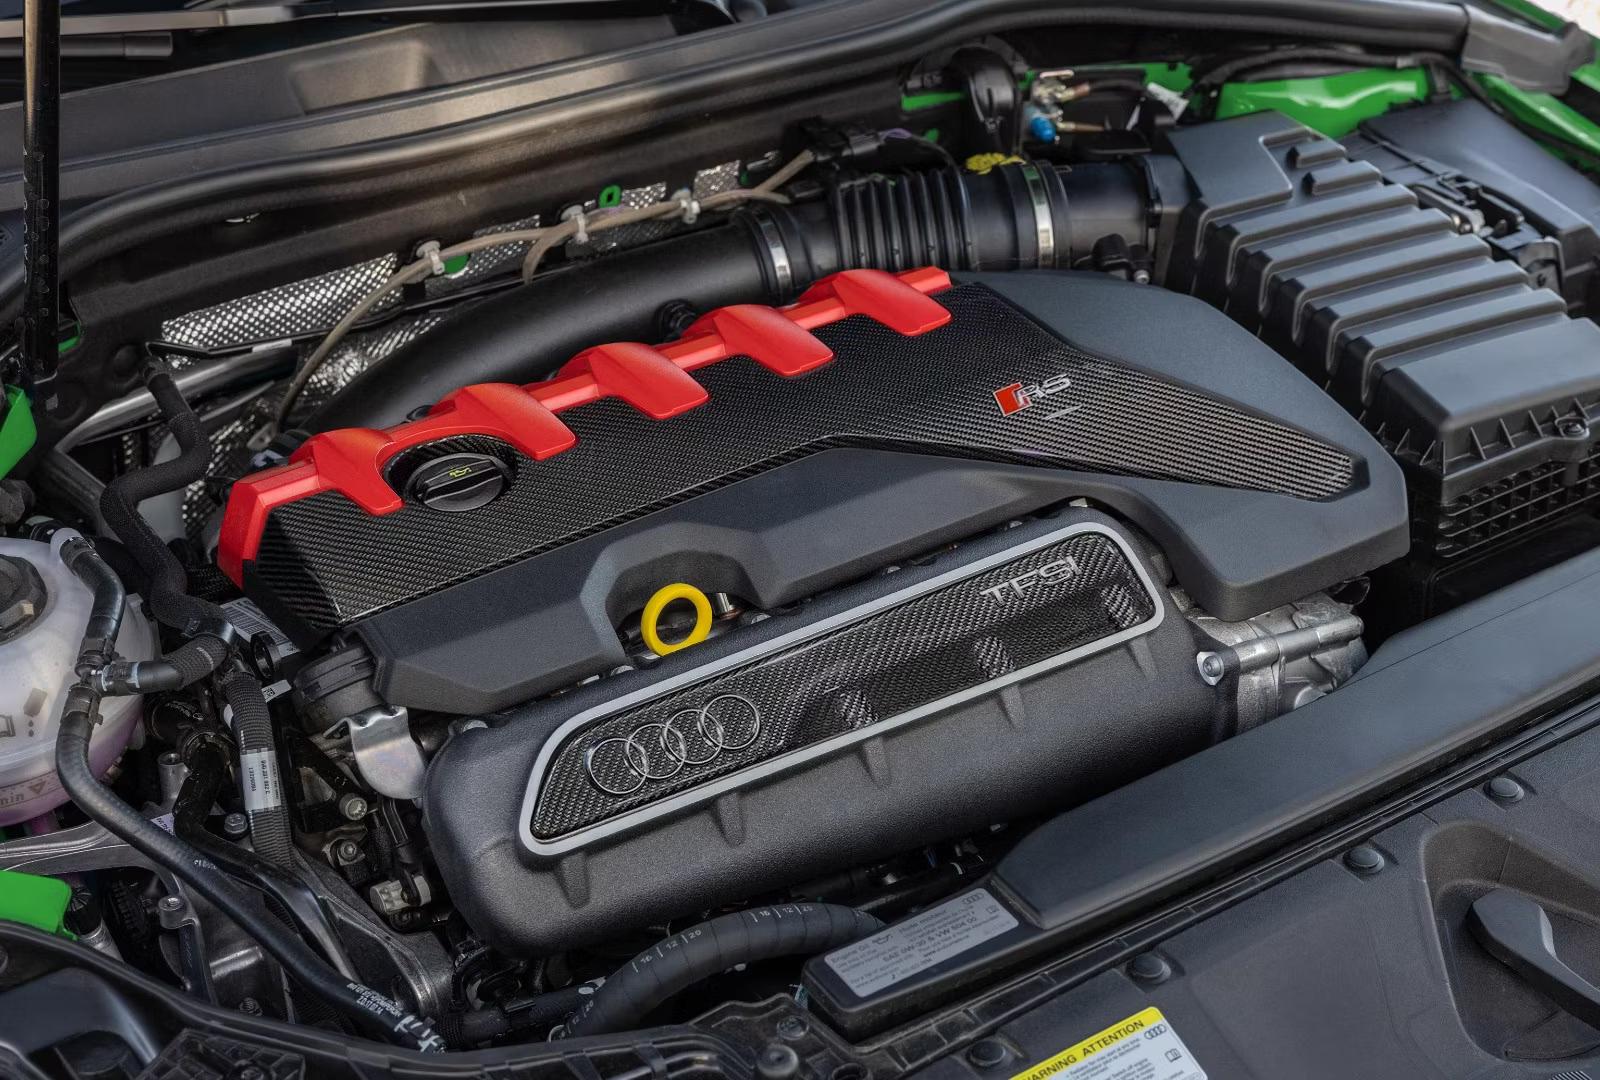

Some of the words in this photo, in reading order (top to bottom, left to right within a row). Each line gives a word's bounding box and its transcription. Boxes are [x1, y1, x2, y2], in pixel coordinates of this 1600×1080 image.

[1012, 373, 1071, 407] RS
[980, 555, 1082, 604] TFSI
[688, 929, 702, 940] 20
[1024, 1054, 1077, 1080] ARNING
[1082, 1019, 1145, 1057] ATTENTION
